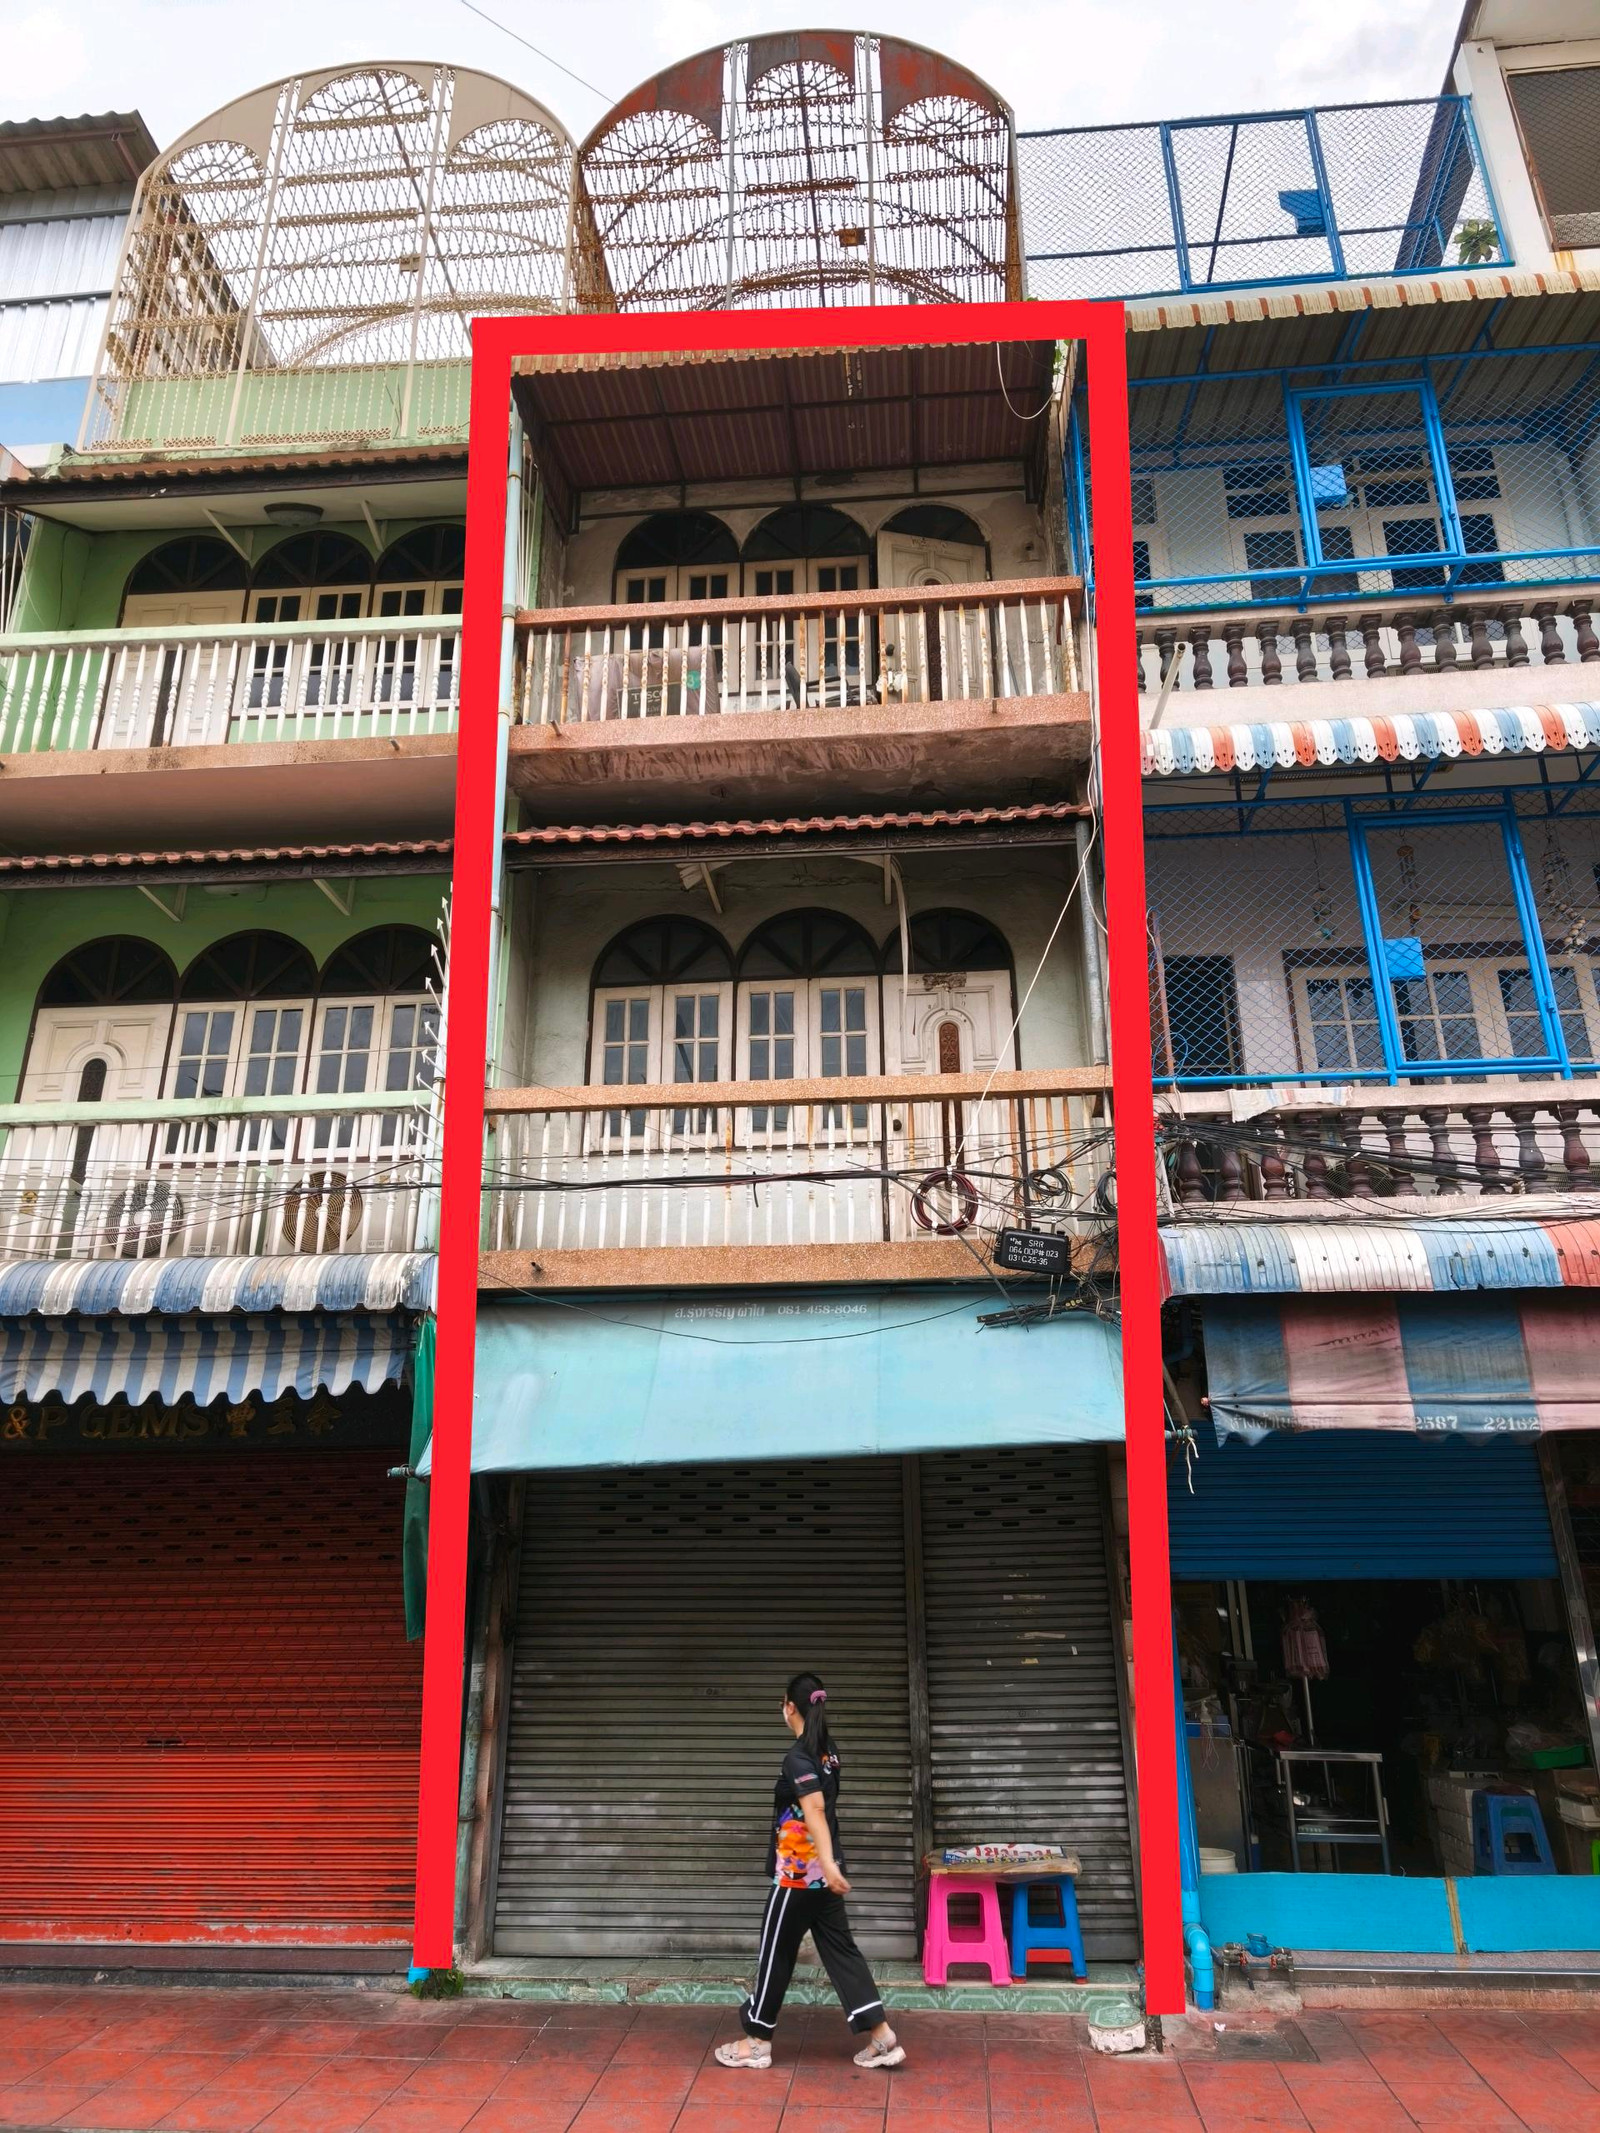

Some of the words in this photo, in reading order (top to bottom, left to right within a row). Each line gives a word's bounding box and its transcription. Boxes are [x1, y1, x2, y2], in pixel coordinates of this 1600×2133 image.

[1028, 1239, 1045, 1248] SRR
[0, 1405, 31, 1440] &
[34, 1405, 69, 1441] P
[79, 1404, 211, 1440] GEMS
